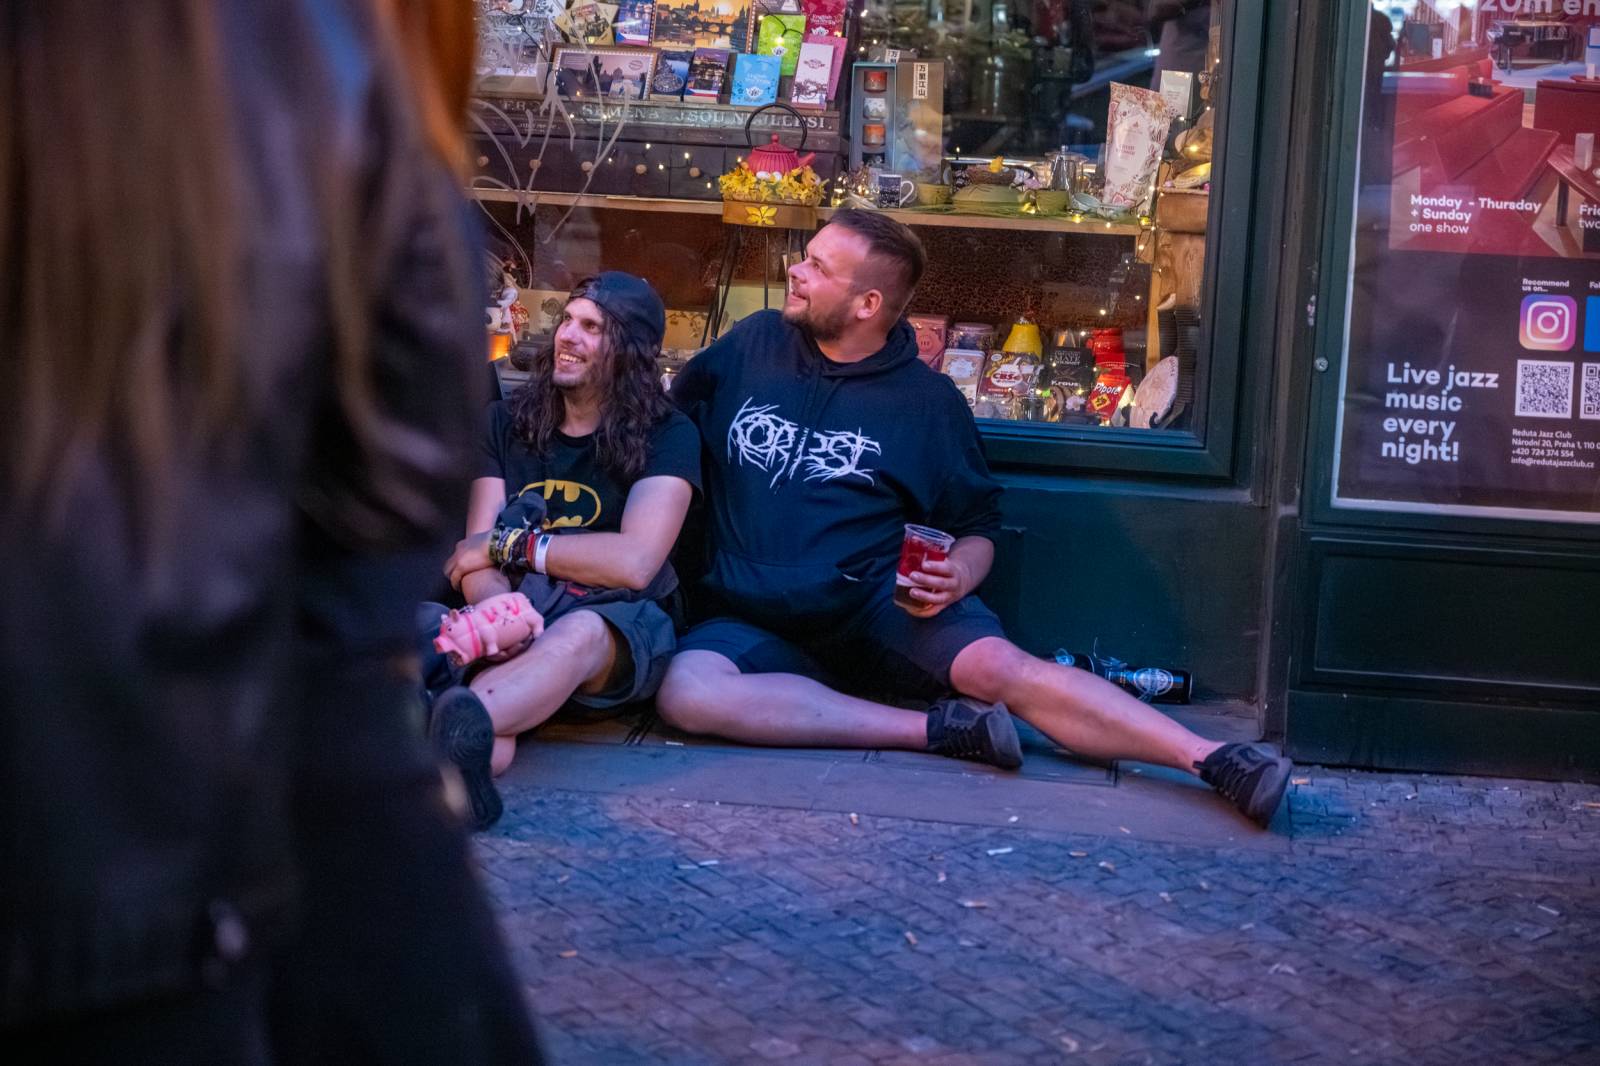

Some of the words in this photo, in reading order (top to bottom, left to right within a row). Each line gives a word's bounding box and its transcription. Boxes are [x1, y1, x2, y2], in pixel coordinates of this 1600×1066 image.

[1410, 194, 1462, 210] Monday
[1478, 197, 1542, 214] Thursday
[1422, 208, 1472, 224] Sunday
[1409, 223, 1432, 233] one
[1436, 222, 1469, 234] show
[1522, 278, 1570, 288] Recommend
[1387, 362, 1441, 385] Live
[1445, 365, 1499, 391] jazz
[1385, 390, 1462, 412] music
[1383, 417, 1456, 441] every
[1512, 428, 1537, 437] Reduta
[1538, 430, 1554, 438] Jazz
[1555, 431, 1572, 439] Club
[1381, 437, 1459, 465] night!
[1554, 440, 1576, 449] Praha
